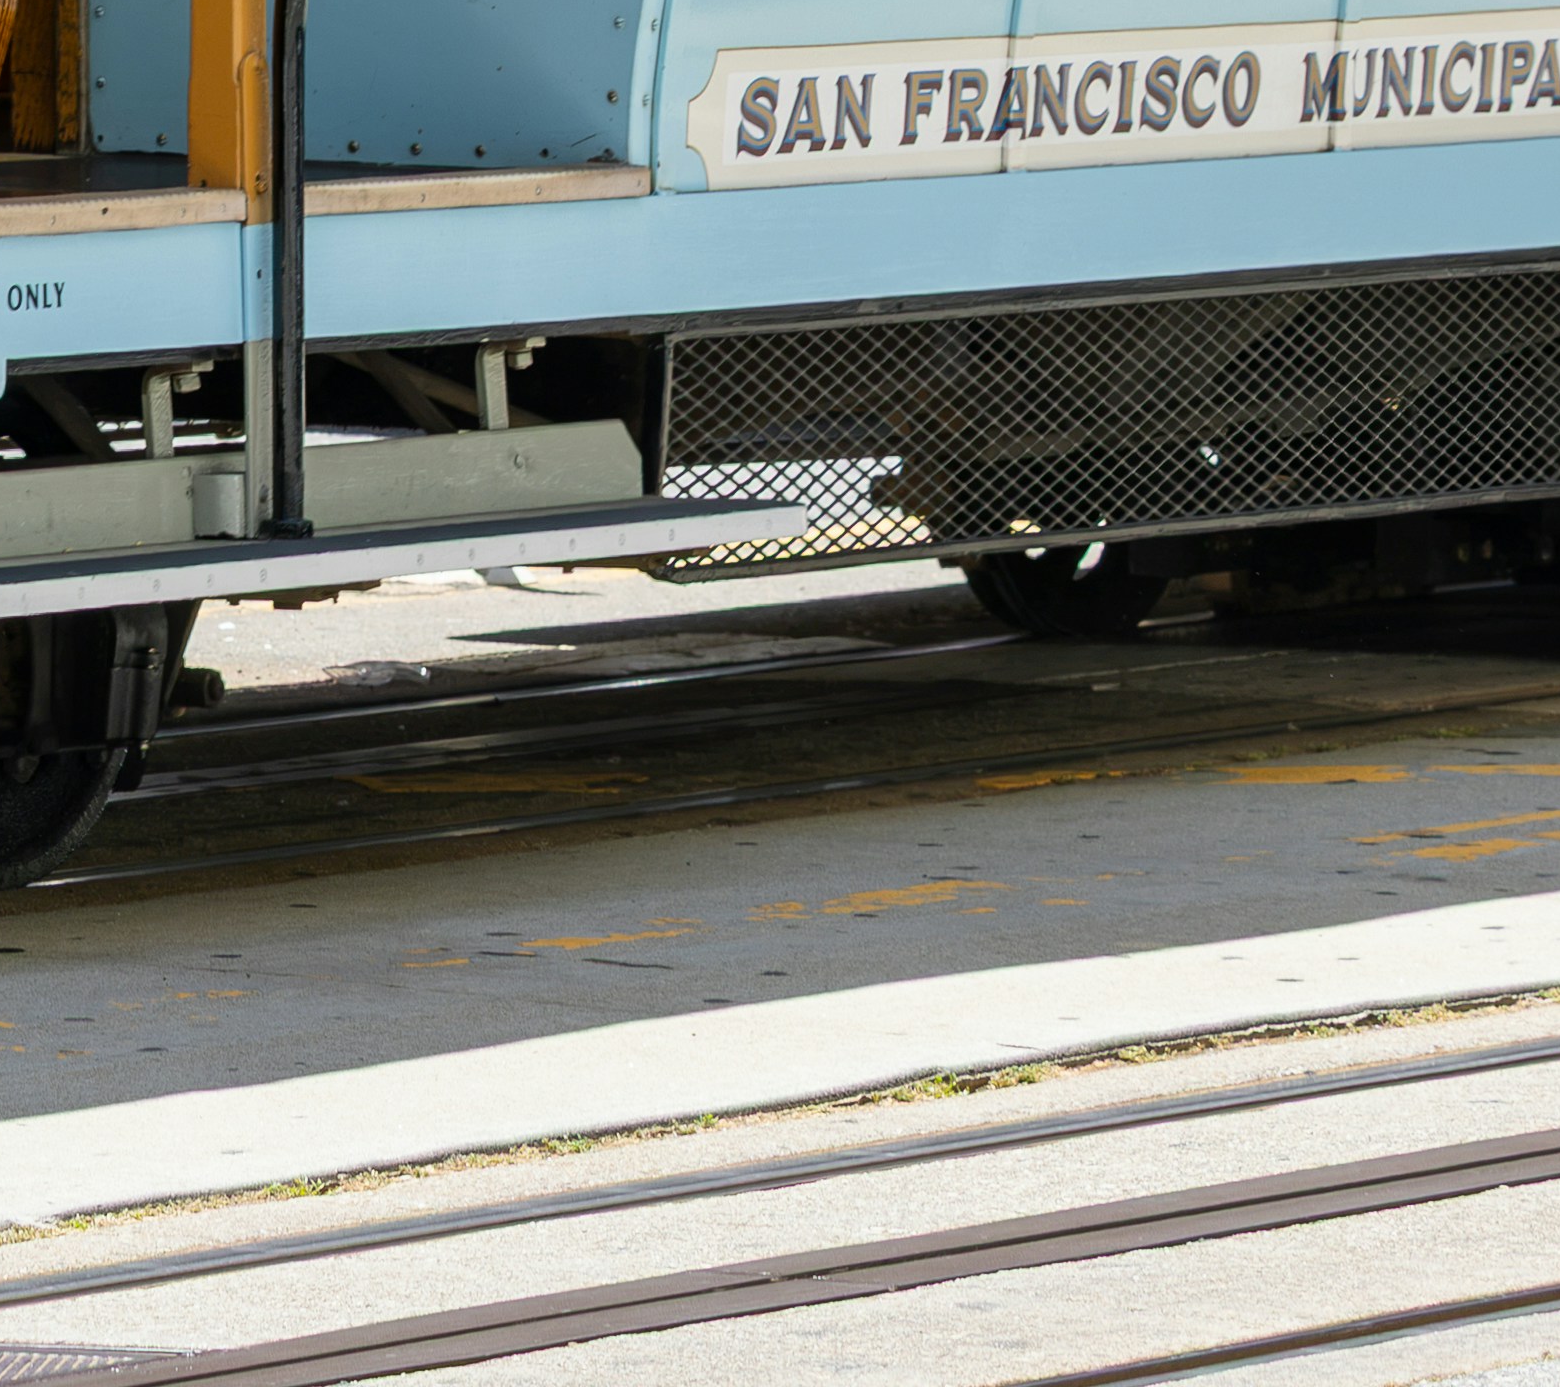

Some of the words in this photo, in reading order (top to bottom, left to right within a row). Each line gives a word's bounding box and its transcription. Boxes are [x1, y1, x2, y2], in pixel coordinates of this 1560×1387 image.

[736, 72, 873, 159] SAN
[900, 49, 1262, 148] FRANCISCO
[7, 282, 66, 313] ONLY
